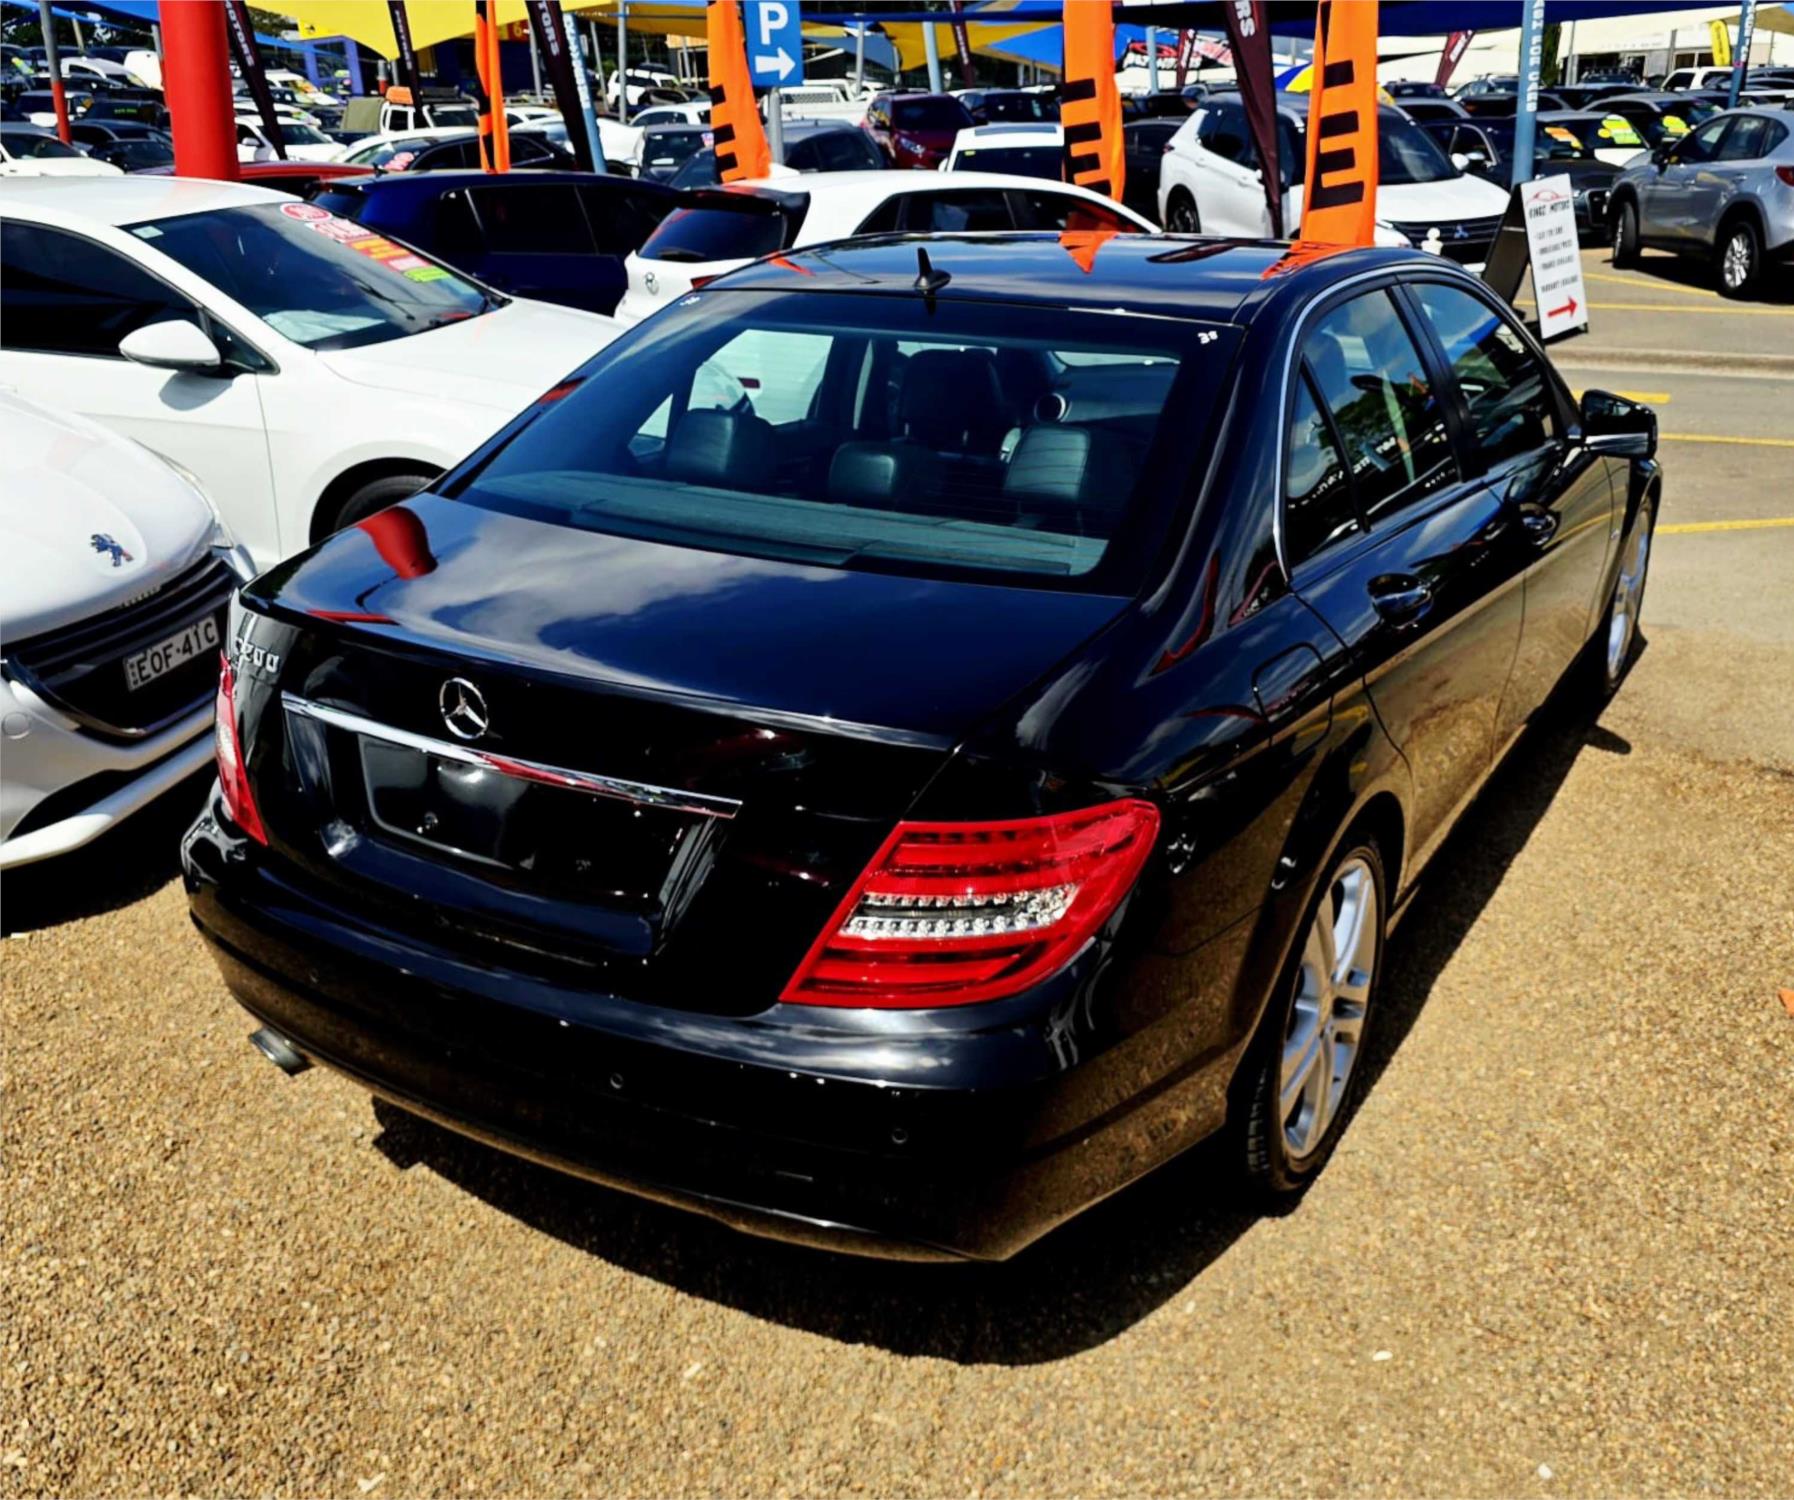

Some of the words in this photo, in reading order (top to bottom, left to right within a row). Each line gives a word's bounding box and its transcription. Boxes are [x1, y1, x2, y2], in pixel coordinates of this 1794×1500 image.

[758, 2, 788, 45] P
[1528, 35, 1542, 67] FOR
[1526, 71, 1540, 113] CARS
